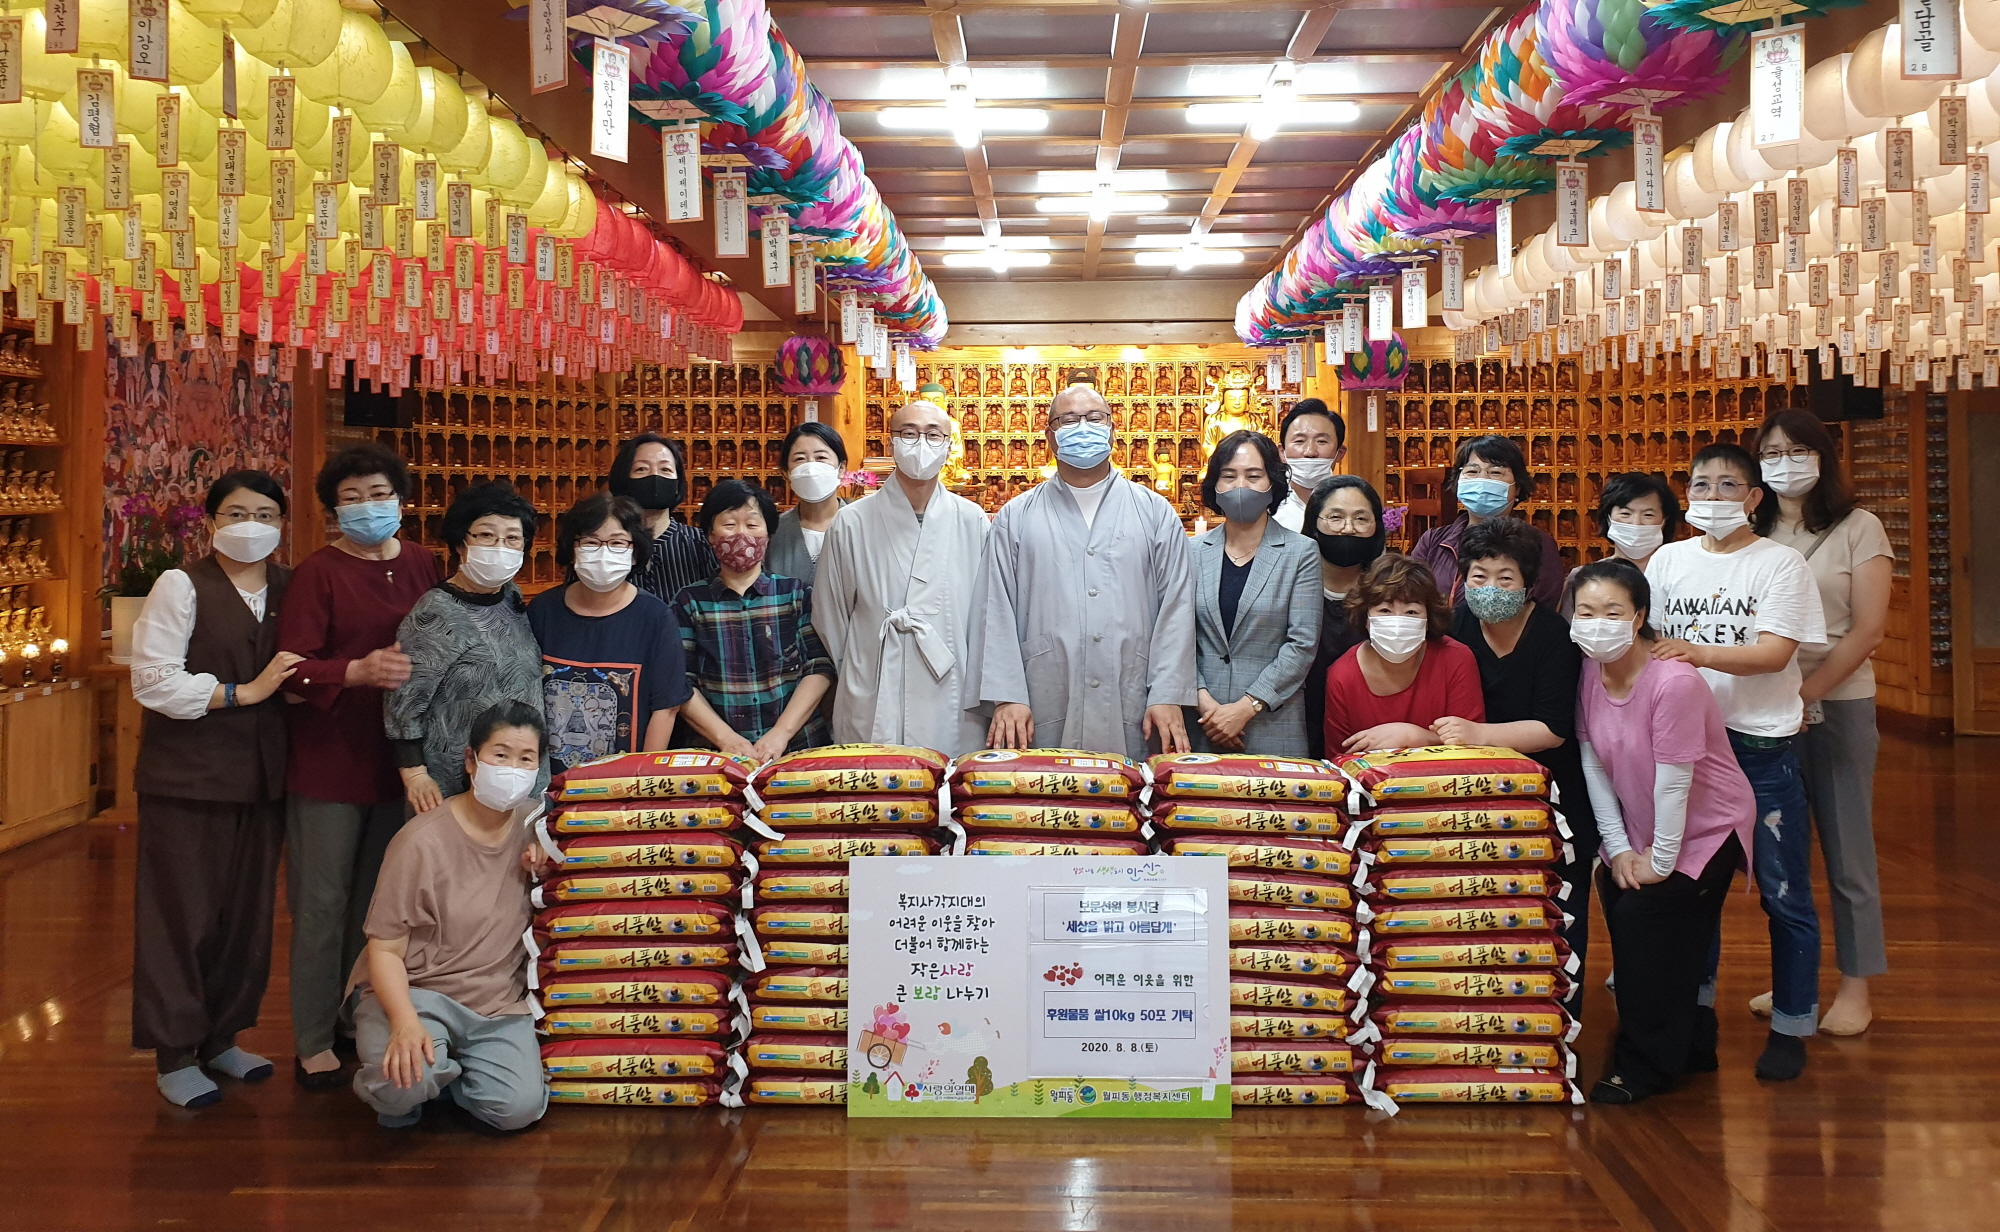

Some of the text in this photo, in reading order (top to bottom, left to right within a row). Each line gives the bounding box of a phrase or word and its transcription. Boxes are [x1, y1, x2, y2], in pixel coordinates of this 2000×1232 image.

[1911, 64, 1928, 72] 28
[898, 893, 986, 911] 복지사각지대의
[1126, 900, 1160, 914] 봉사단
[889, 914, 996, 932] 어려운 이웃을 찾아
[1103, 920, 1125, 934] 밝고
[894, 935, 990, 954] 더불어 함께하는
[1094, 973, 1194, 987] 어려운 이웃을 위한
[896, 984, 989, 1003] 큰 보람 나누기
[1046, 1008, 1194, 1023] 후원물품 쌀10kg 50포 기탁
[1081, 1042, 1112, 1053] 2020.
[1116, 1042, 1126, 1053] 8.
[1050, 1089, 1074, 1103] 월피동
[1102, 1091, 1191, 1102] 월피동 행정복지센터
